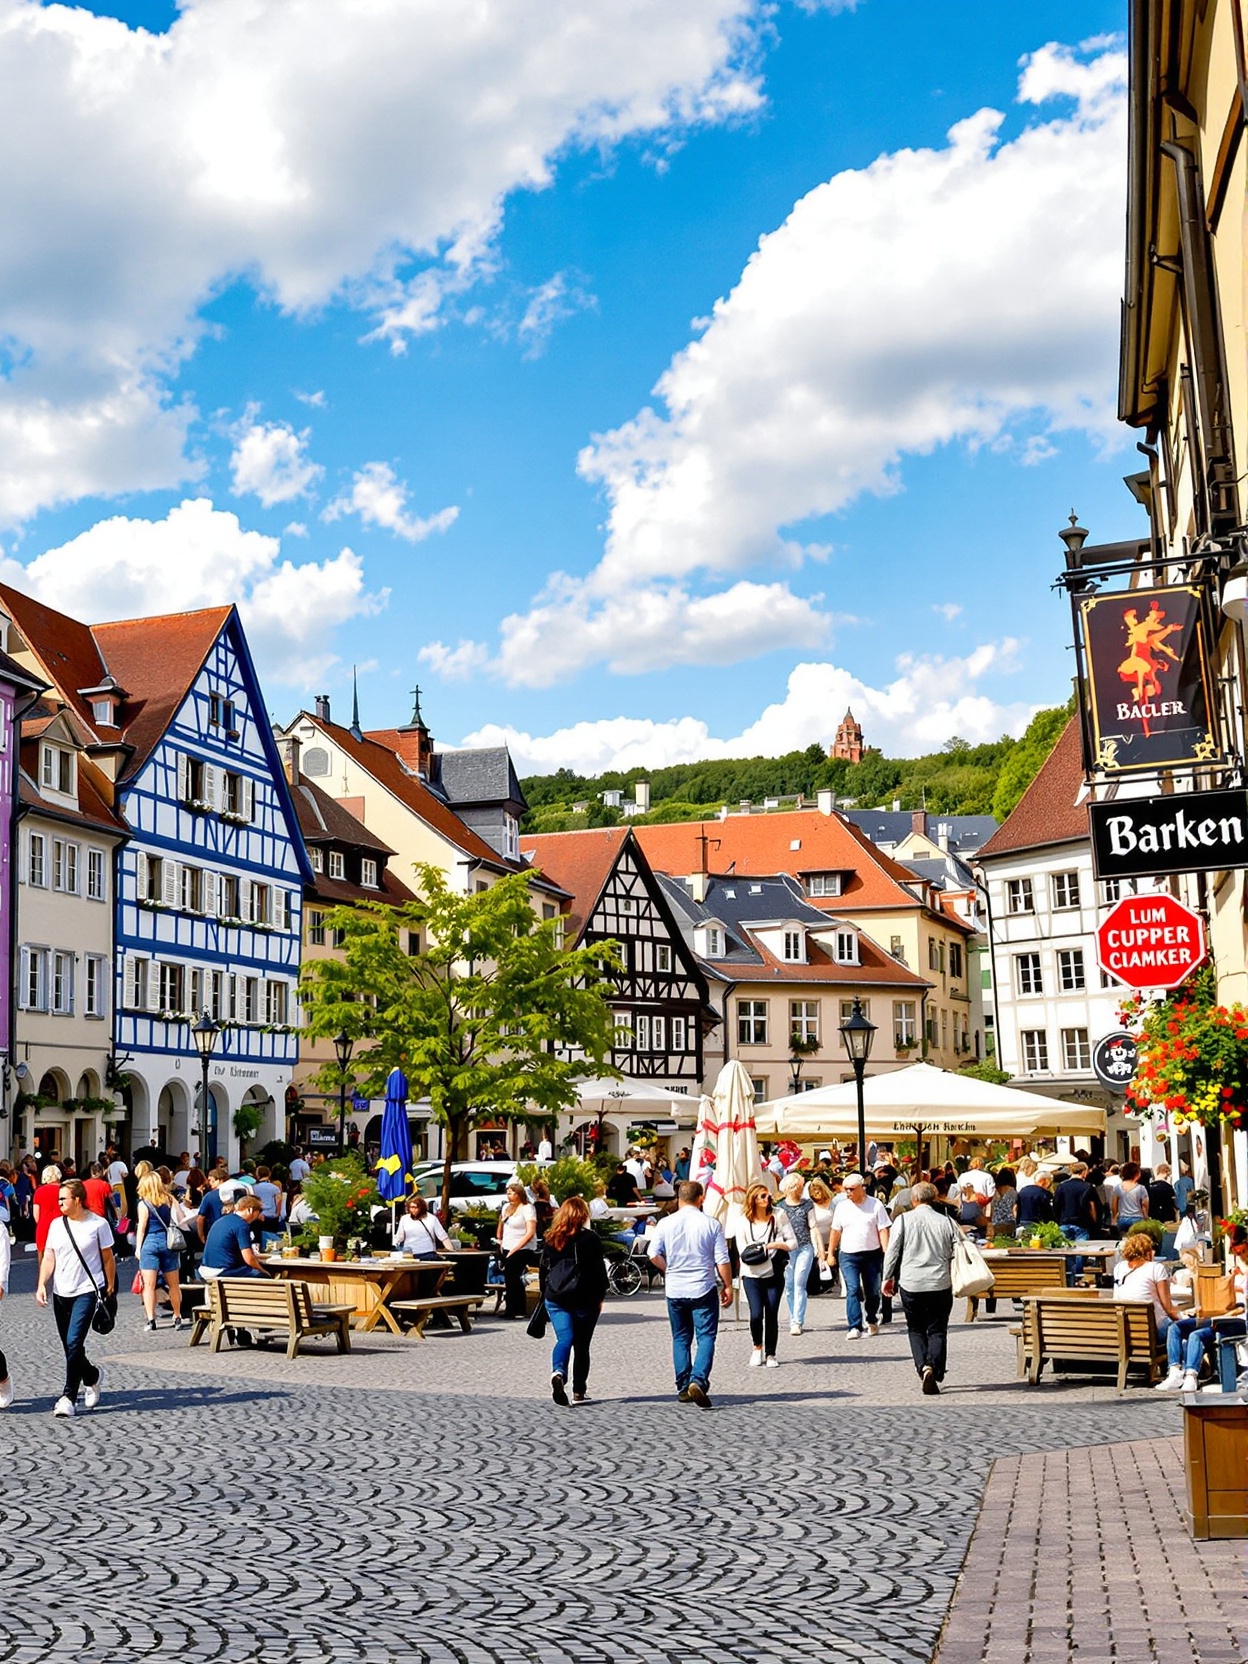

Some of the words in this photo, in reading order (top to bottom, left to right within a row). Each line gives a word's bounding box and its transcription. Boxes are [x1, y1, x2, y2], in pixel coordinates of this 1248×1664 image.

[1105, 809, 1245, 856] Barken
[1129, 907, 1167, 925] LUM
[1107, 926, 1191, 948] CUPPER
